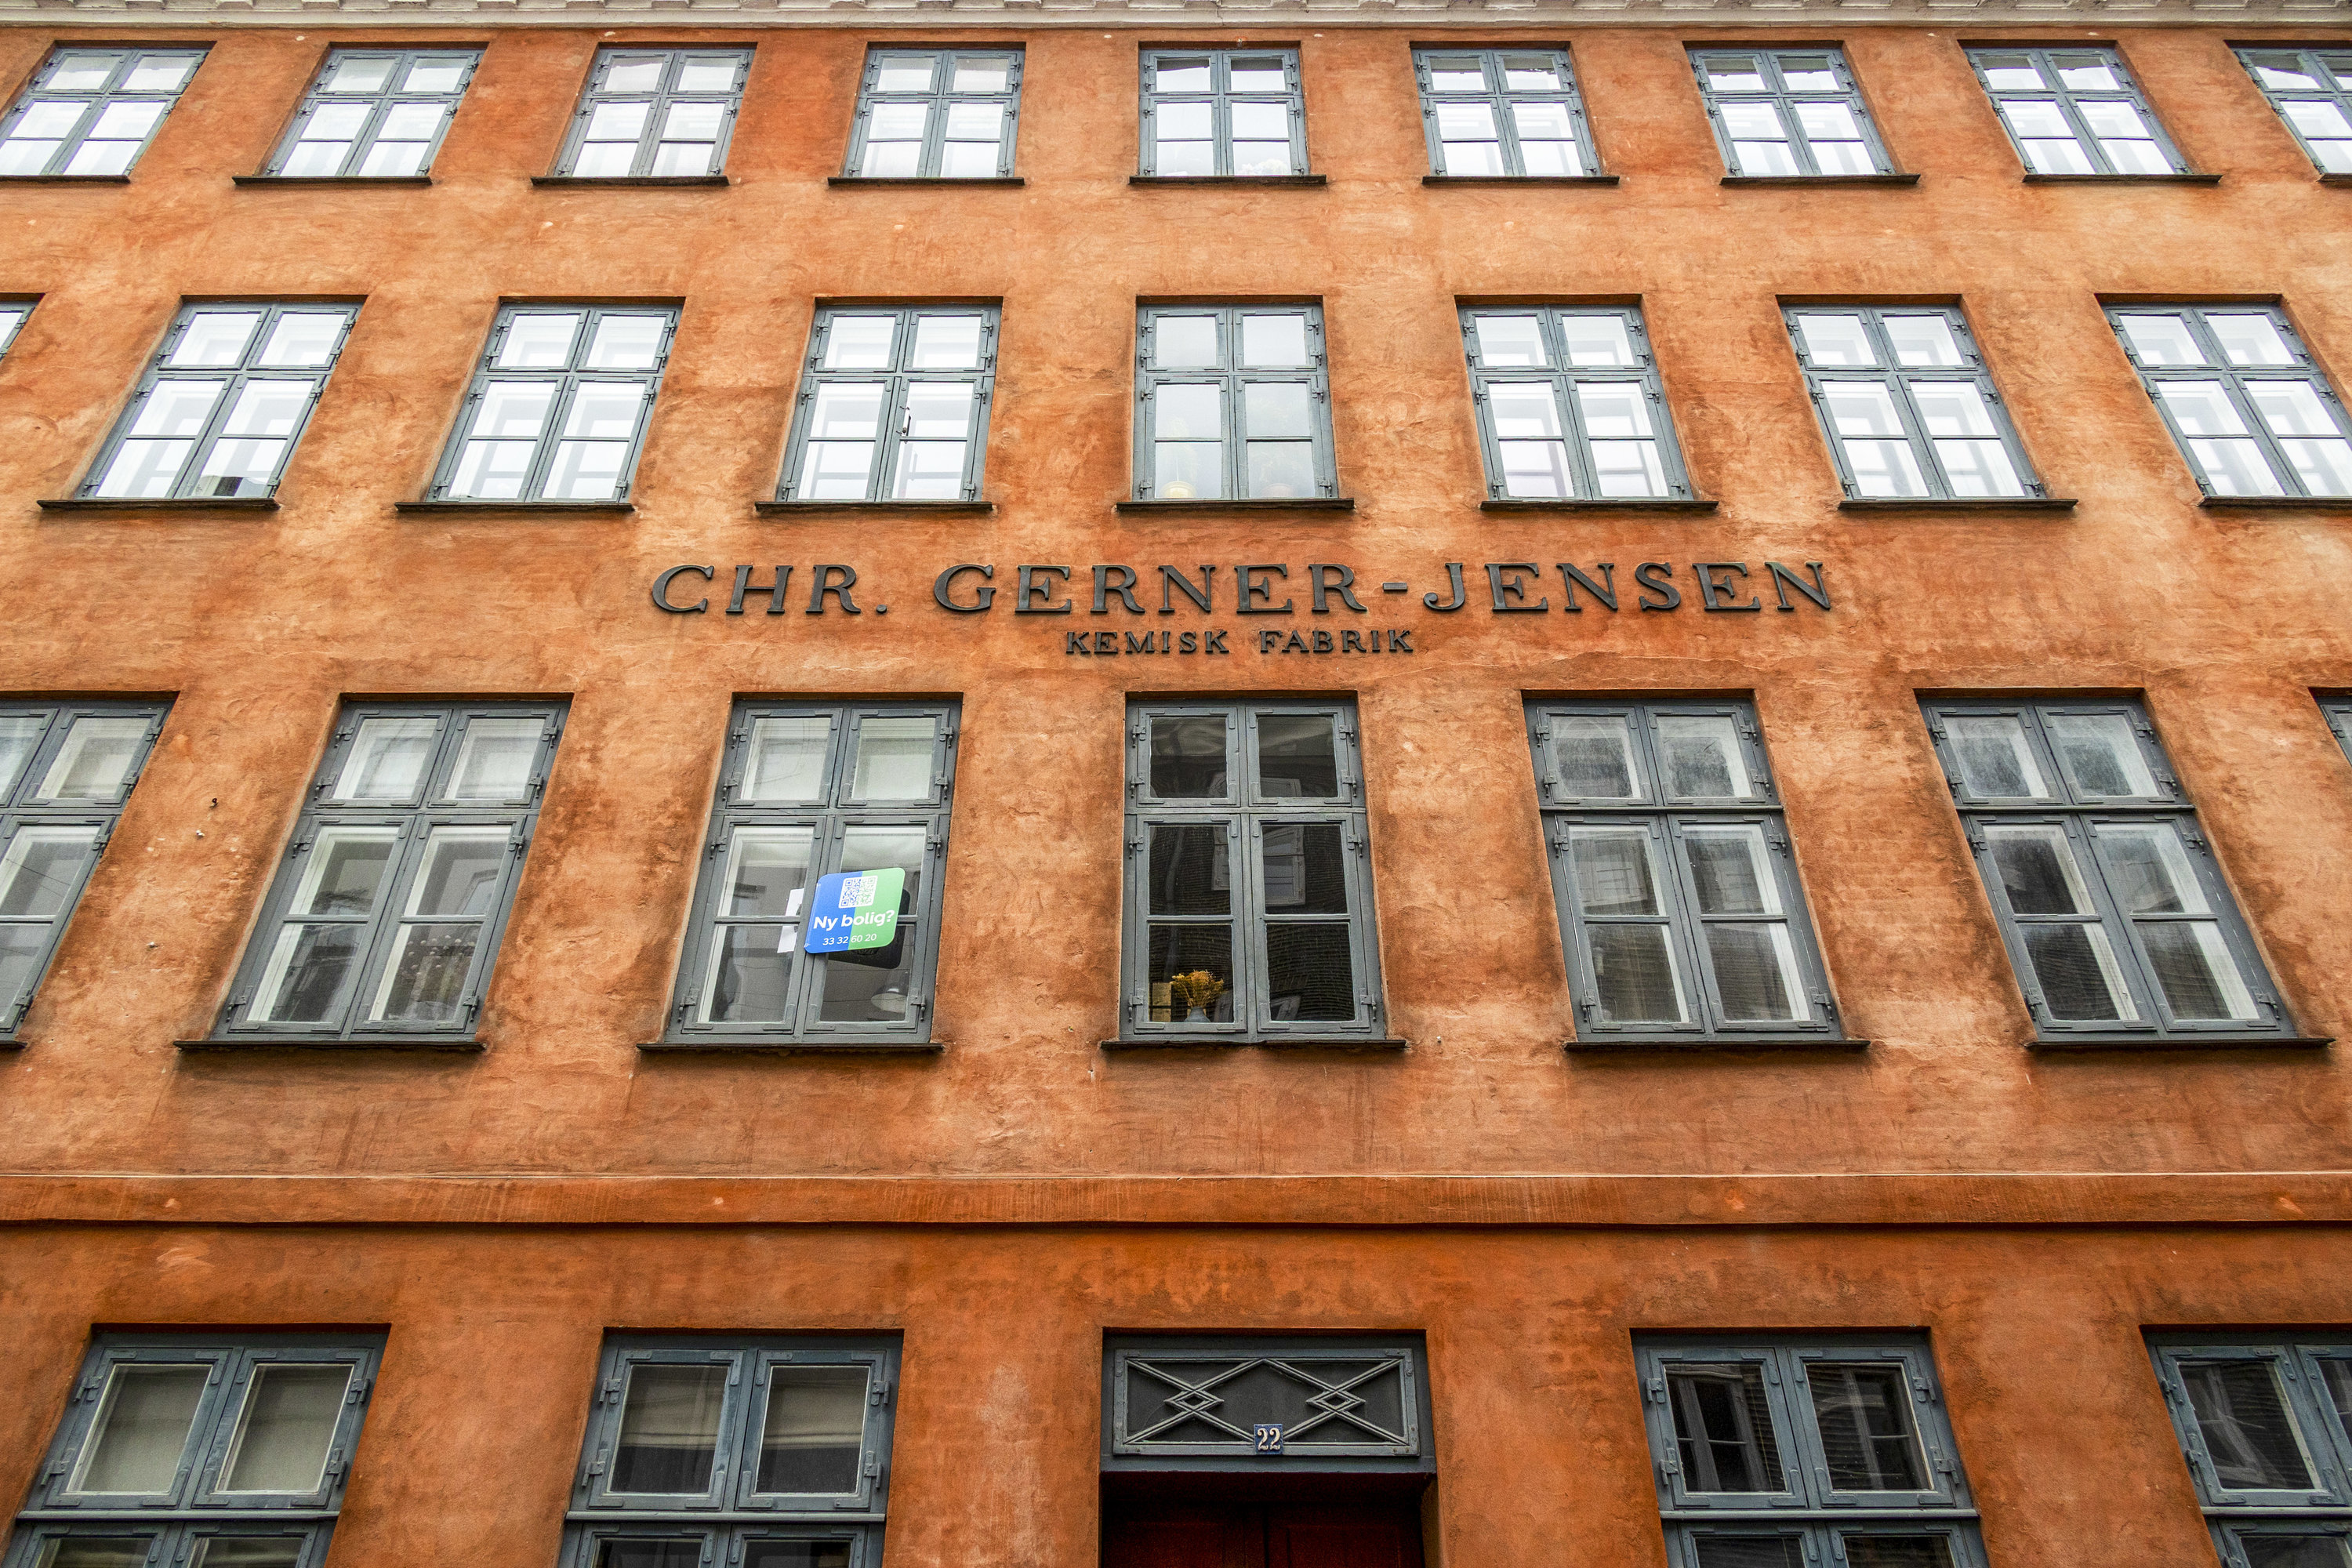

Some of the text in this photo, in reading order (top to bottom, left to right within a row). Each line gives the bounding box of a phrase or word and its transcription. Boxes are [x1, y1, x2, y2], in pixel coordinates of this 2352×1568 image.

[652, 561, 1831, 615] CHR. GERNER-JENSEN
[1065, 630, 1413, 655] KEMISK FABRIK
[813, 909, 895, 931] Ny bolig?
[822, 933, 877, 946] 33 32 60 20
[1257, 1427, 1281, 1450] 22
